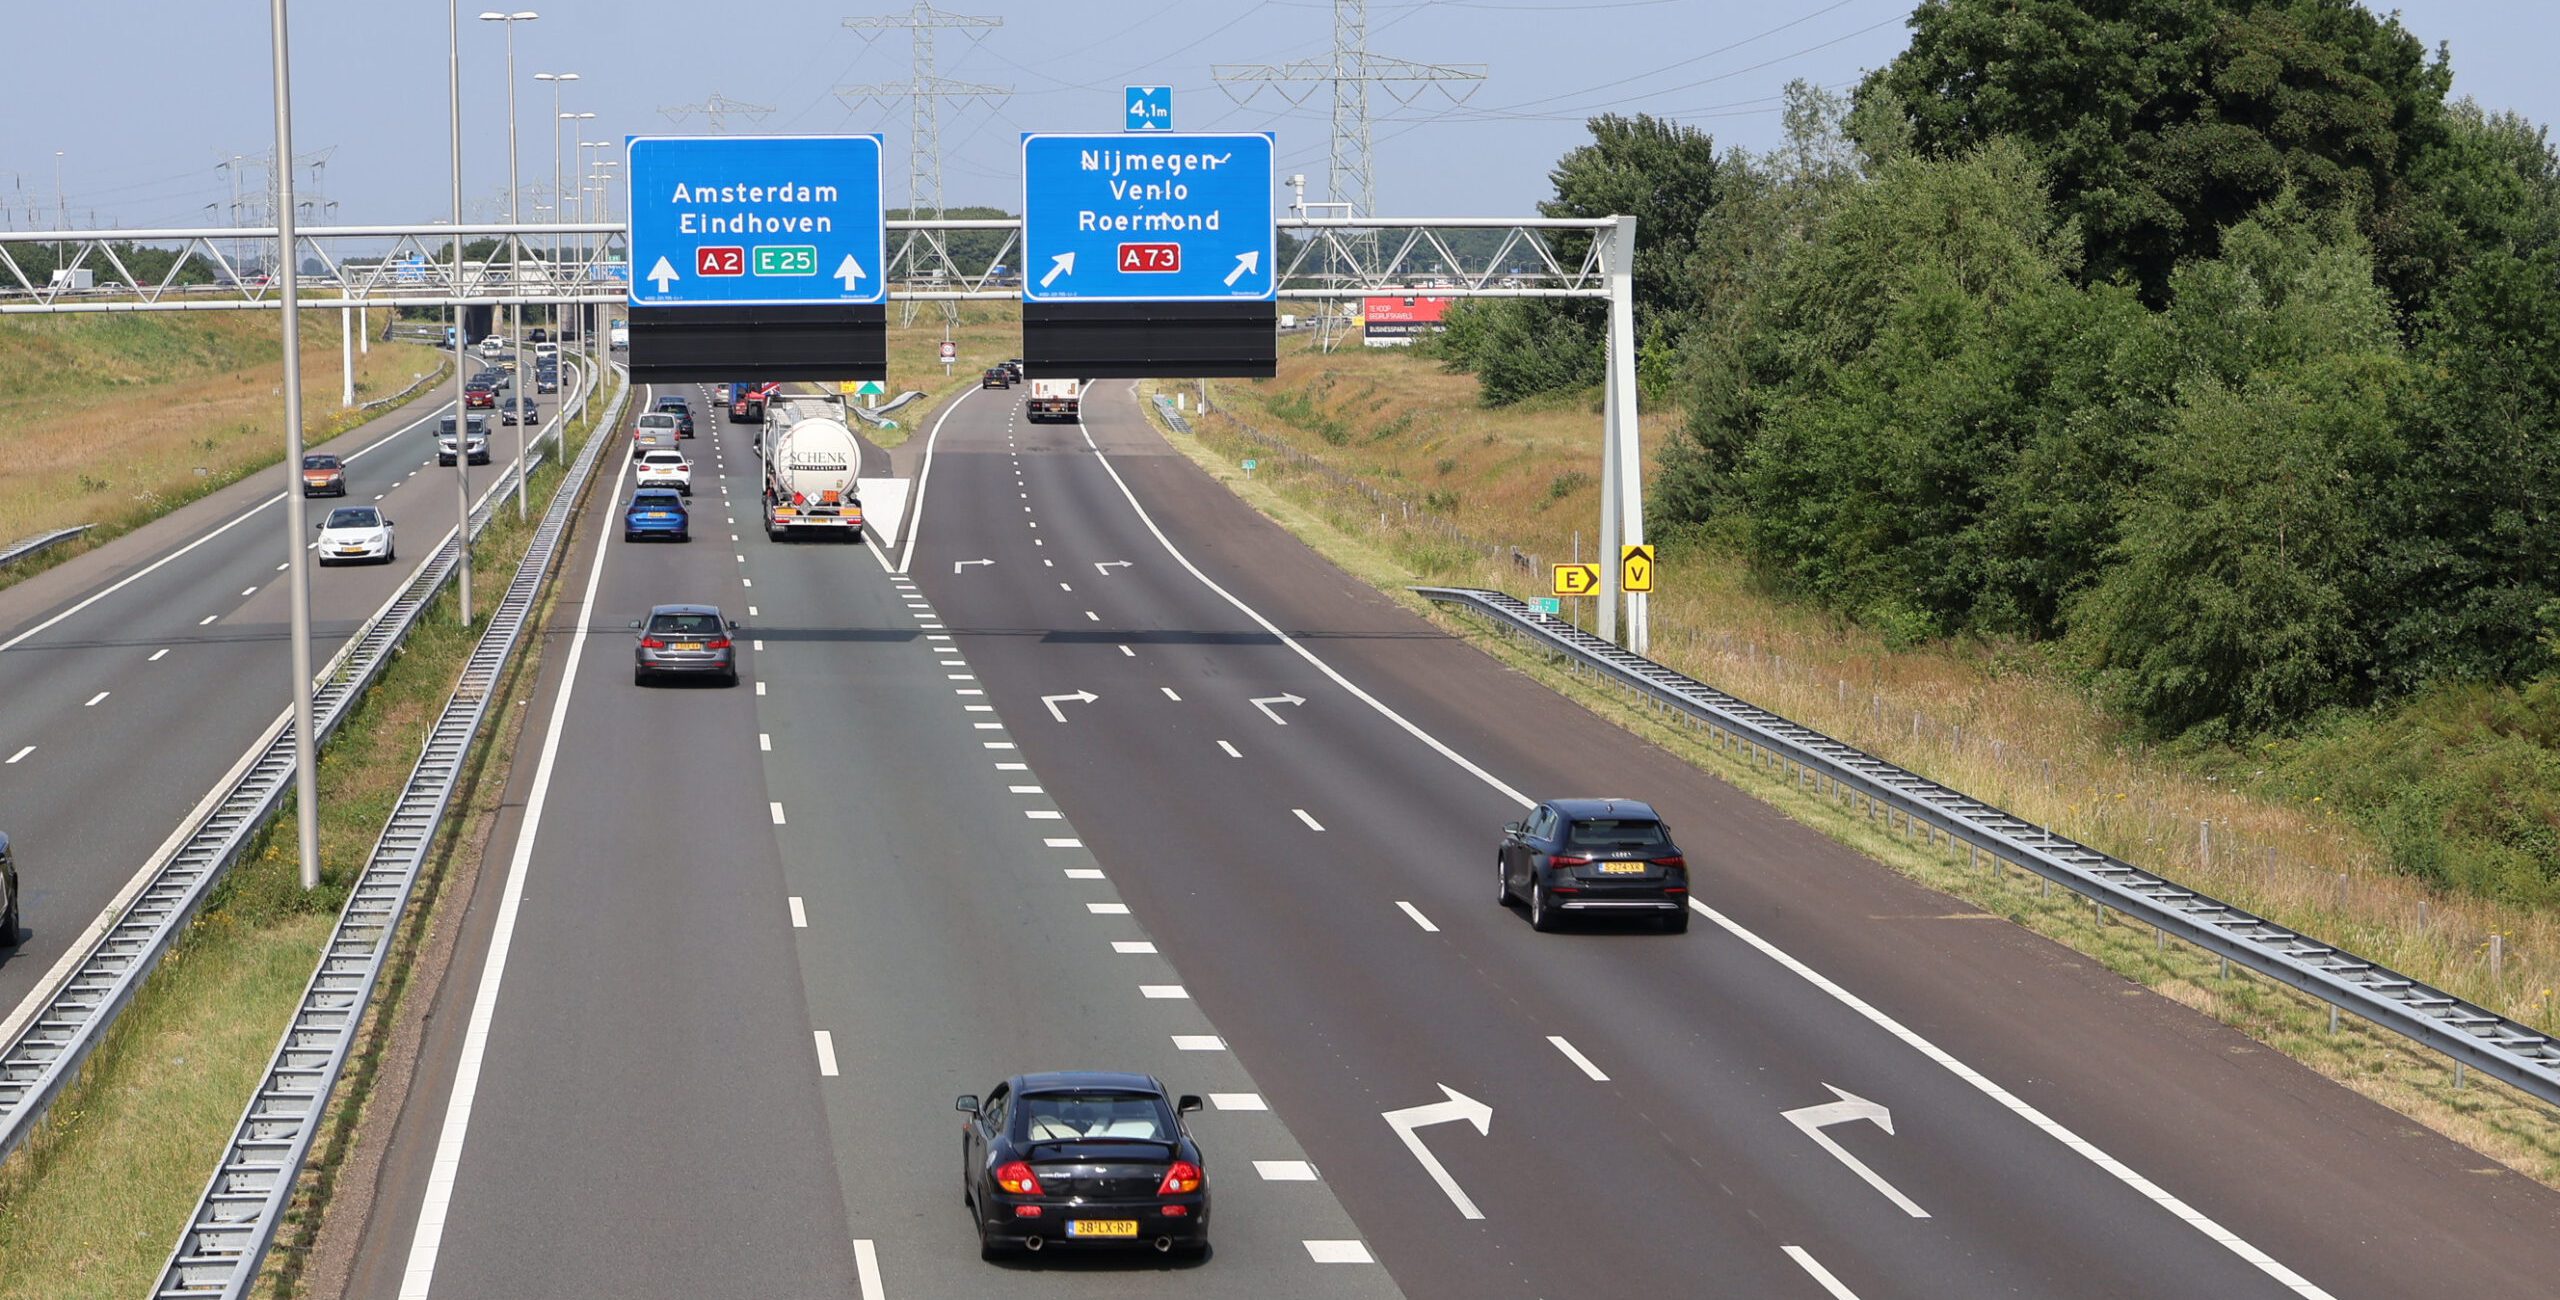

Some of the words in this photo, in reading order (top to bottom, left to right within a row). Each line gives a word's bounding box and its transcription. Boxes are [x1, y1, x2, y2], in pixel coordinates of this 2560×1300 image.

[1129, 99, 1167, 118] 4,1m
[1081, 150, 1217, 176] Nijmegen
[672, 181, 838, 203] Amsterdam
[1109, 179, 1188, 201] Venlo
[680, 212, 832, 234] Eindhoven
[1079, 209, 1219, 231] Roermond
[703, 252, 738, 271] A2
[790, 451, 846, 463] SCHENK
[1566, 571, 1579, 588] E
[1631, 566, 1644, 582] V
